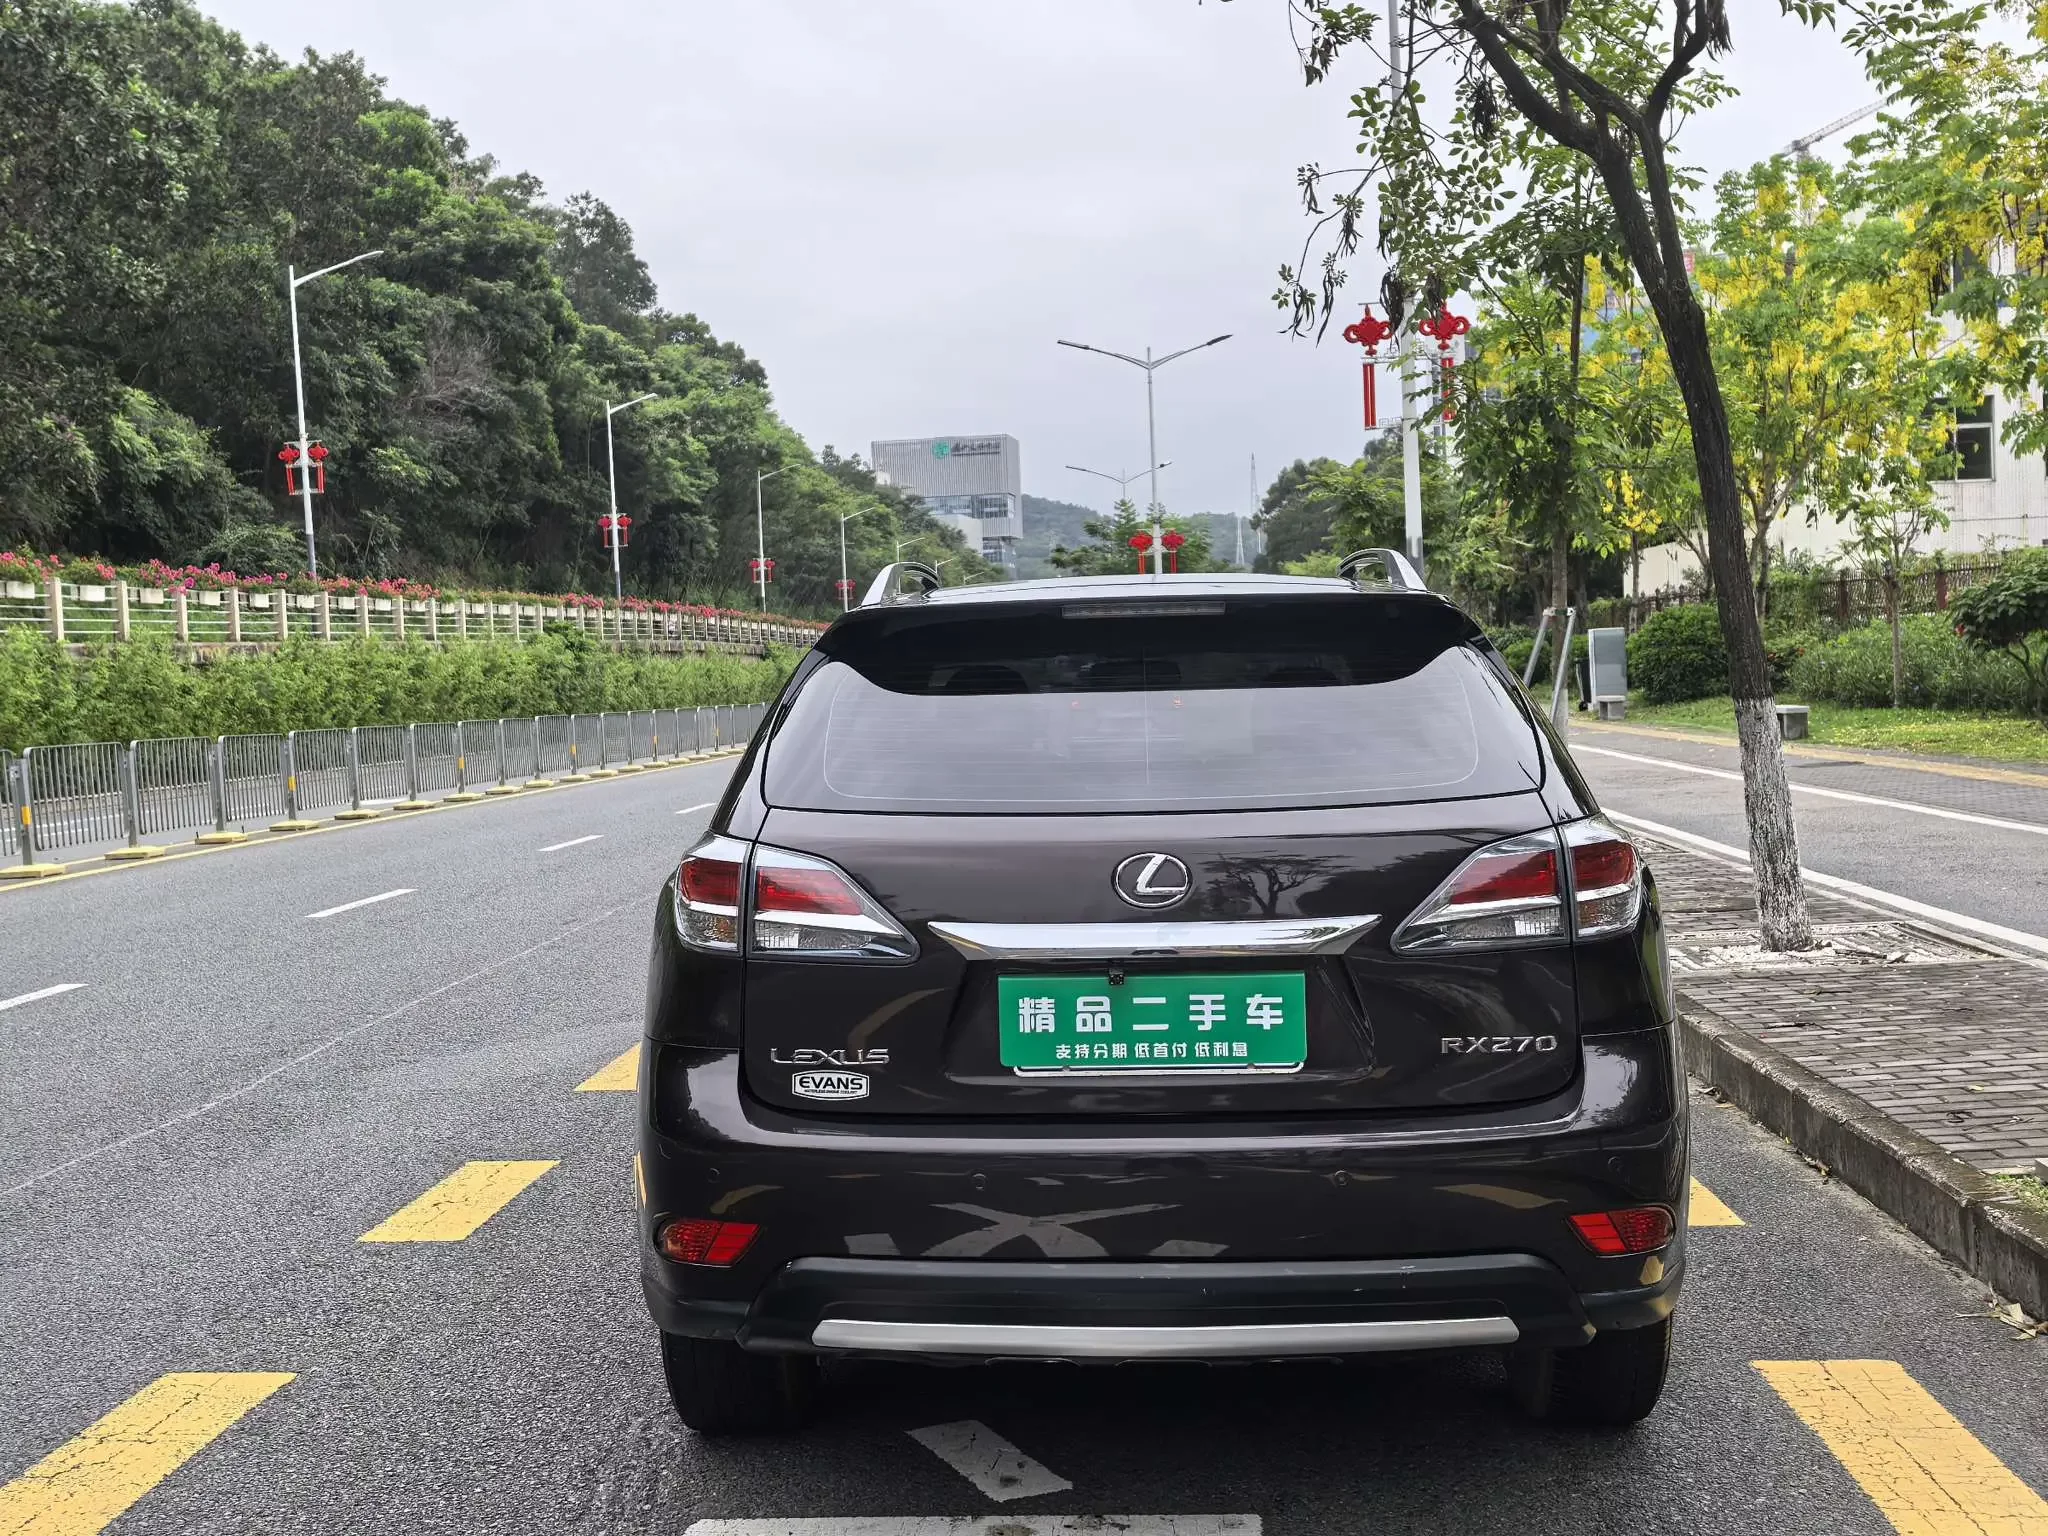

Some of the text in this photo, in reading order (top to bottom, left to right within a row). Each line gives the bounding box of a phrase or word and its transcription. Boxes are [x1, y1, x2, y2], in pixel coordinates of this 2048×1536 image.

[1018, 993, 1285, 1034] 精品二手车
[1055, 1042, 1249, 1060] 支持分期 低首付 低利息
[1440, 1035, 1559, 1054] RX270
[770, 1047, 891, 1066] LEXUS
[799, 1076, 863, 1090] EVANS
